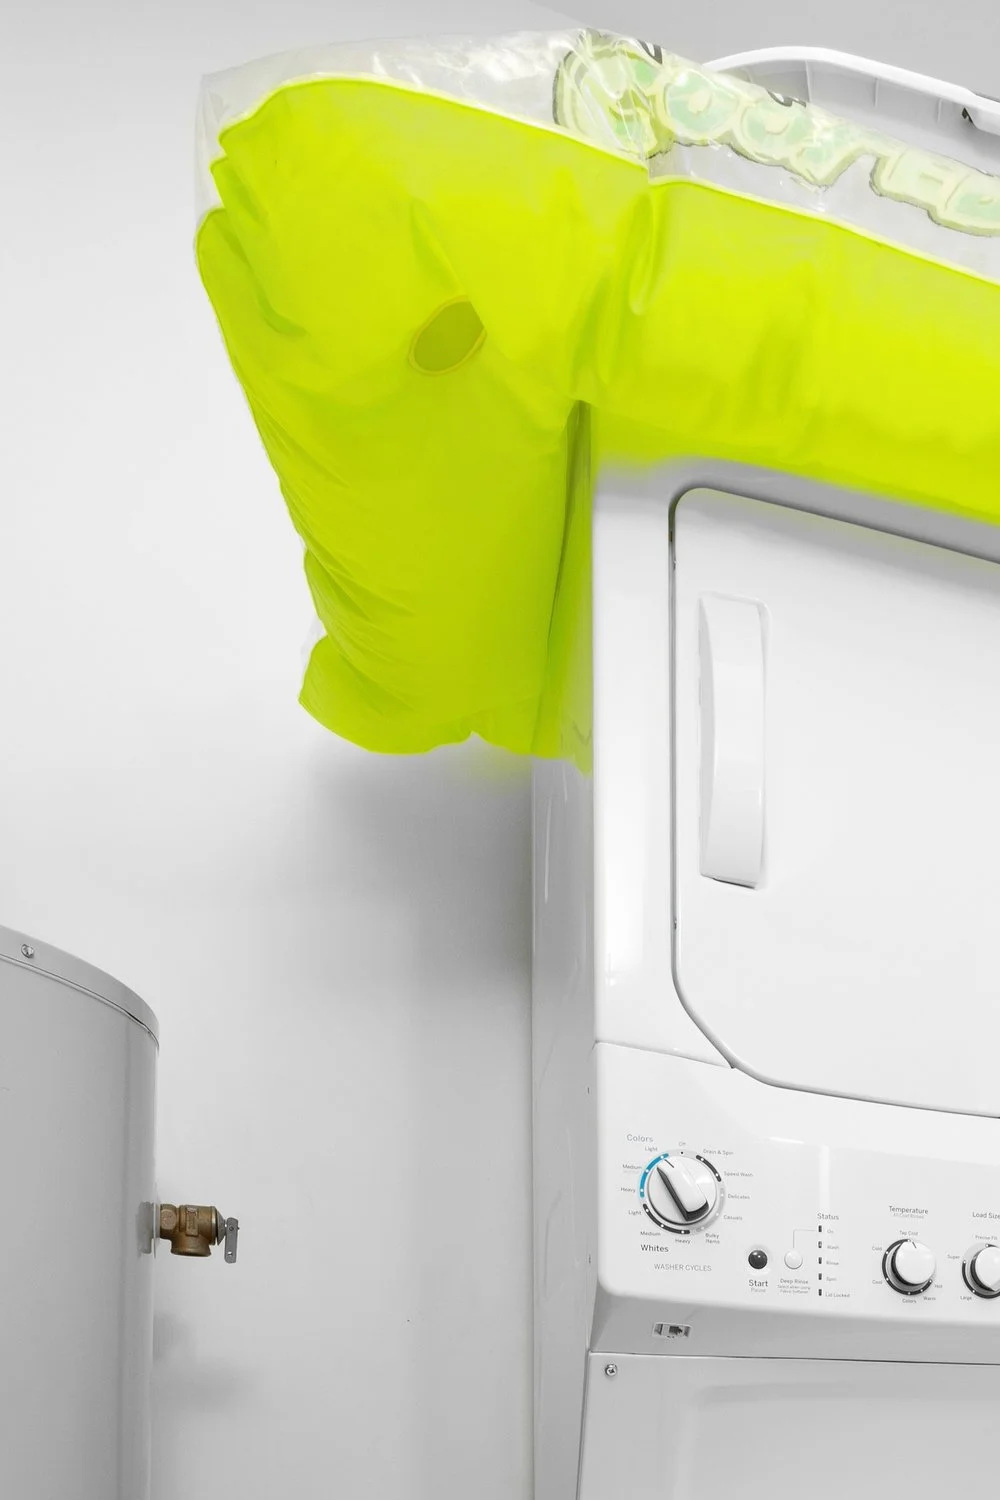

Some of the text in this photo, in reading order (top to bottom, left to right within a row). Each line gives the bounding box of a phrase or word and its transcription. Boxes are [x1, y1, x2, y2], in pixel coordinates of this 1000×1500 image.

[627, 1133, 653, 1142] Colors
[888, 1205, 929, 1215] Temperature
[816, 1212, 840, 1221] Status
[972, 1211, 1000, 1220] Load Size
[640, 1244, 669, 1253] Whites
[653, 1263, 712, 1273] WASHER CYCLES
[748, 1278, 768, 1287] Start
